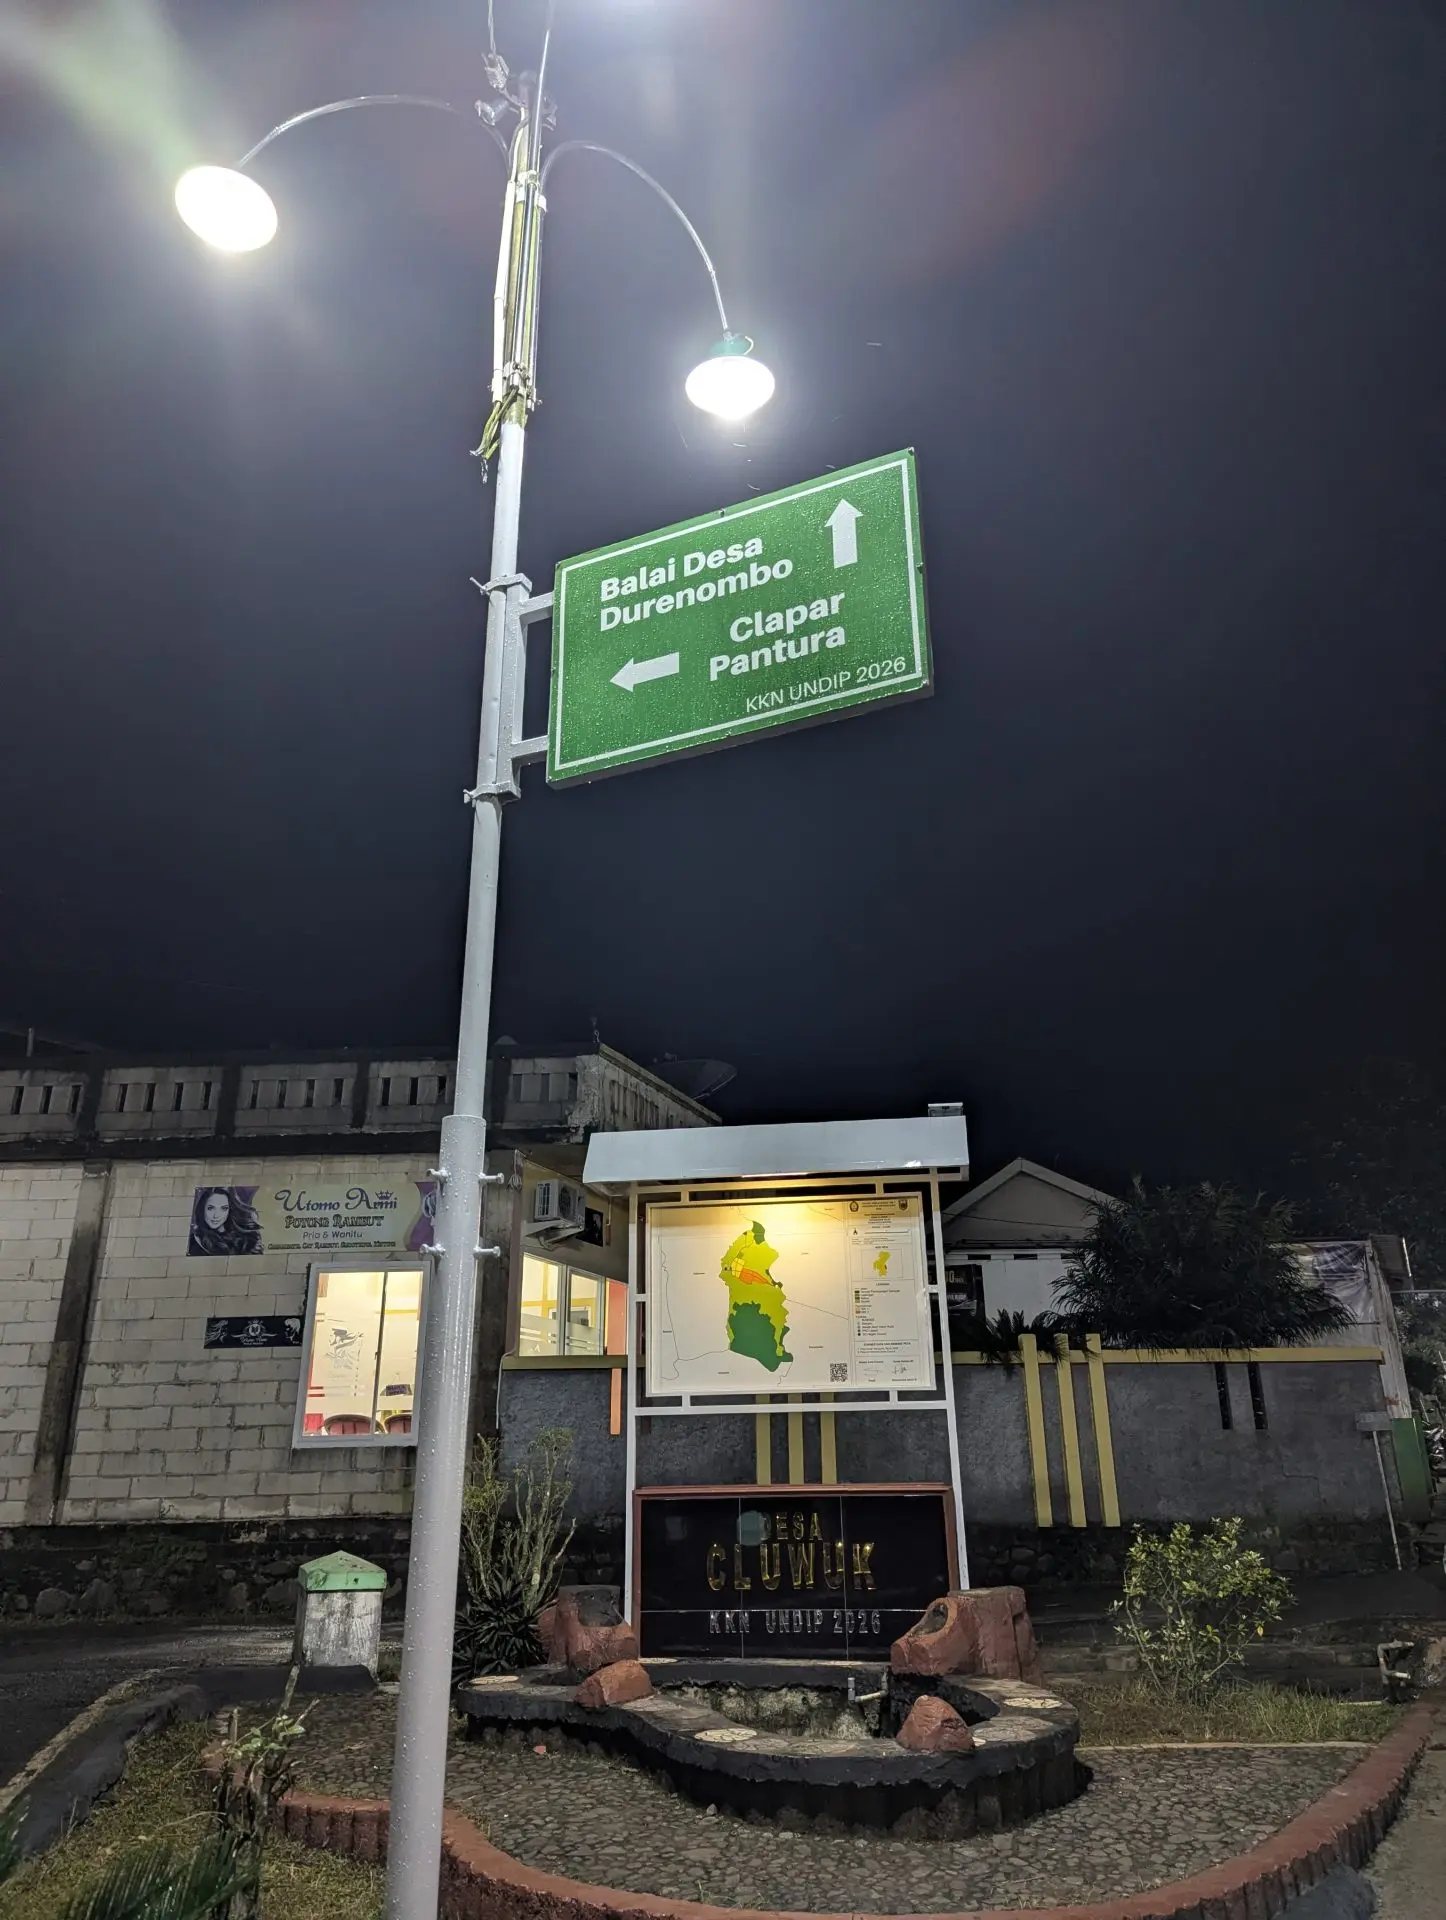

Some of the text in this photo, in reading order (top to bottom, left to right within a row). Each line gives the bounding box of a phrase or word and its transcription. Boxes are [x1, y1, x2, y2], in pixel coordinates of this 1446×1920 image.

[600, 557, 793, 631] Durenombo
[601, 537, 763, 601] Balai Desa
[729, 592, 845, 643] Clapar
[710, 626, 845, 681] Pantura
[746, 656, 906, 713] KKN UNDIP 2026
[274, 1189, 341, 1212] Utomo
[303, 1230, 320, 1239] Pria
[323, 1230, 329, 1238] &
[760, 1511, 823, 1541] DESA
[707, 1541, 877, 1591] CLUWUK
[709, 1610, 881, 1635] KKN UNDIP 2026
